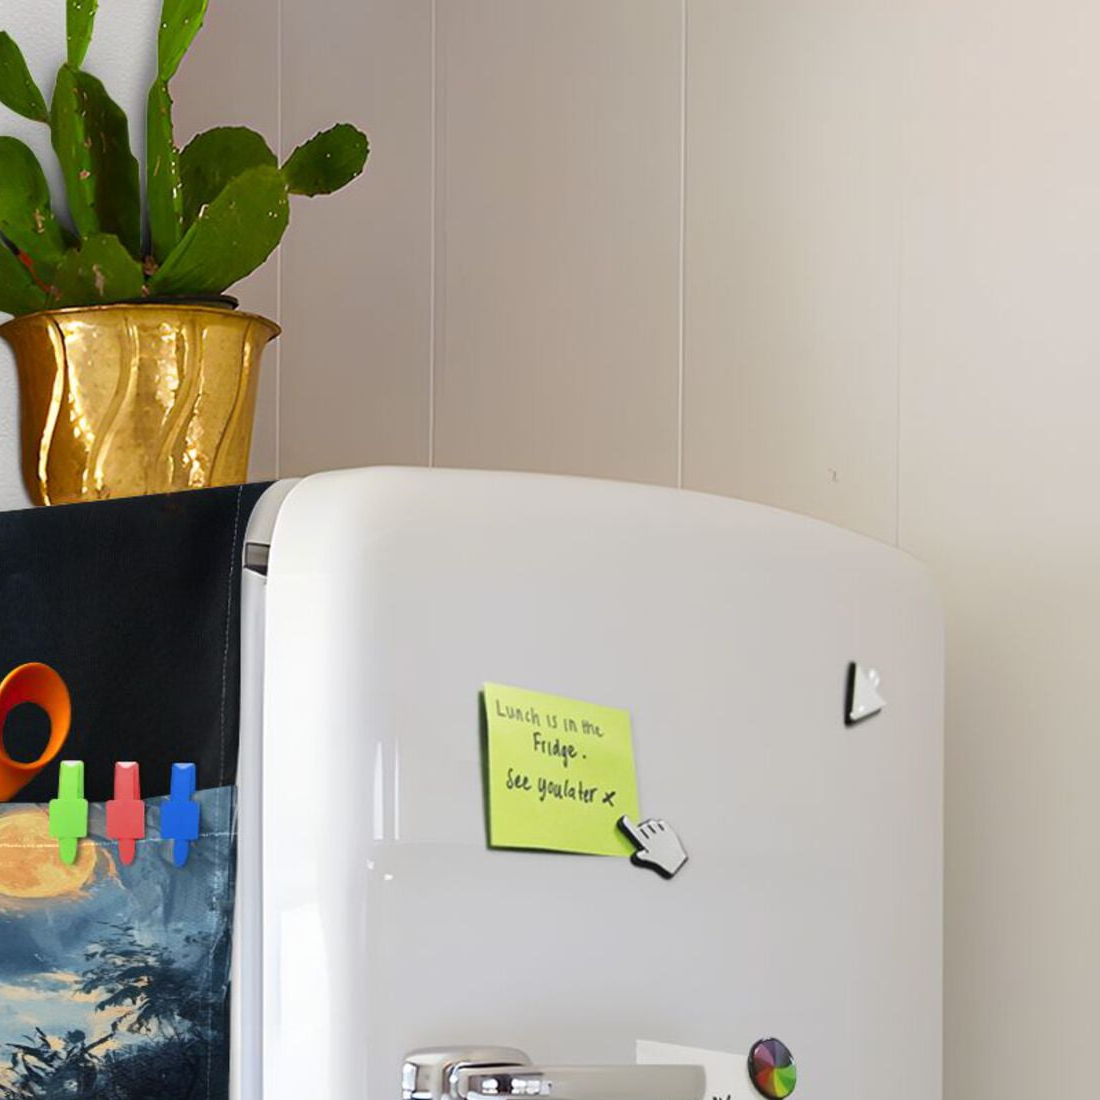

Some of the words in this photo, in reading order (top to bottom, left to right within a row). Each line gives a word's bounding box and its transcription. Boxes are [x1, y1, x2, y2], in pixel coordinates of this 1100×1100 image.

[496, 699, 540, 727] Lunch
[564, 718, 578, 733] in
[582, 719, 603, 738] the
[506, 768, 532, 790] See
